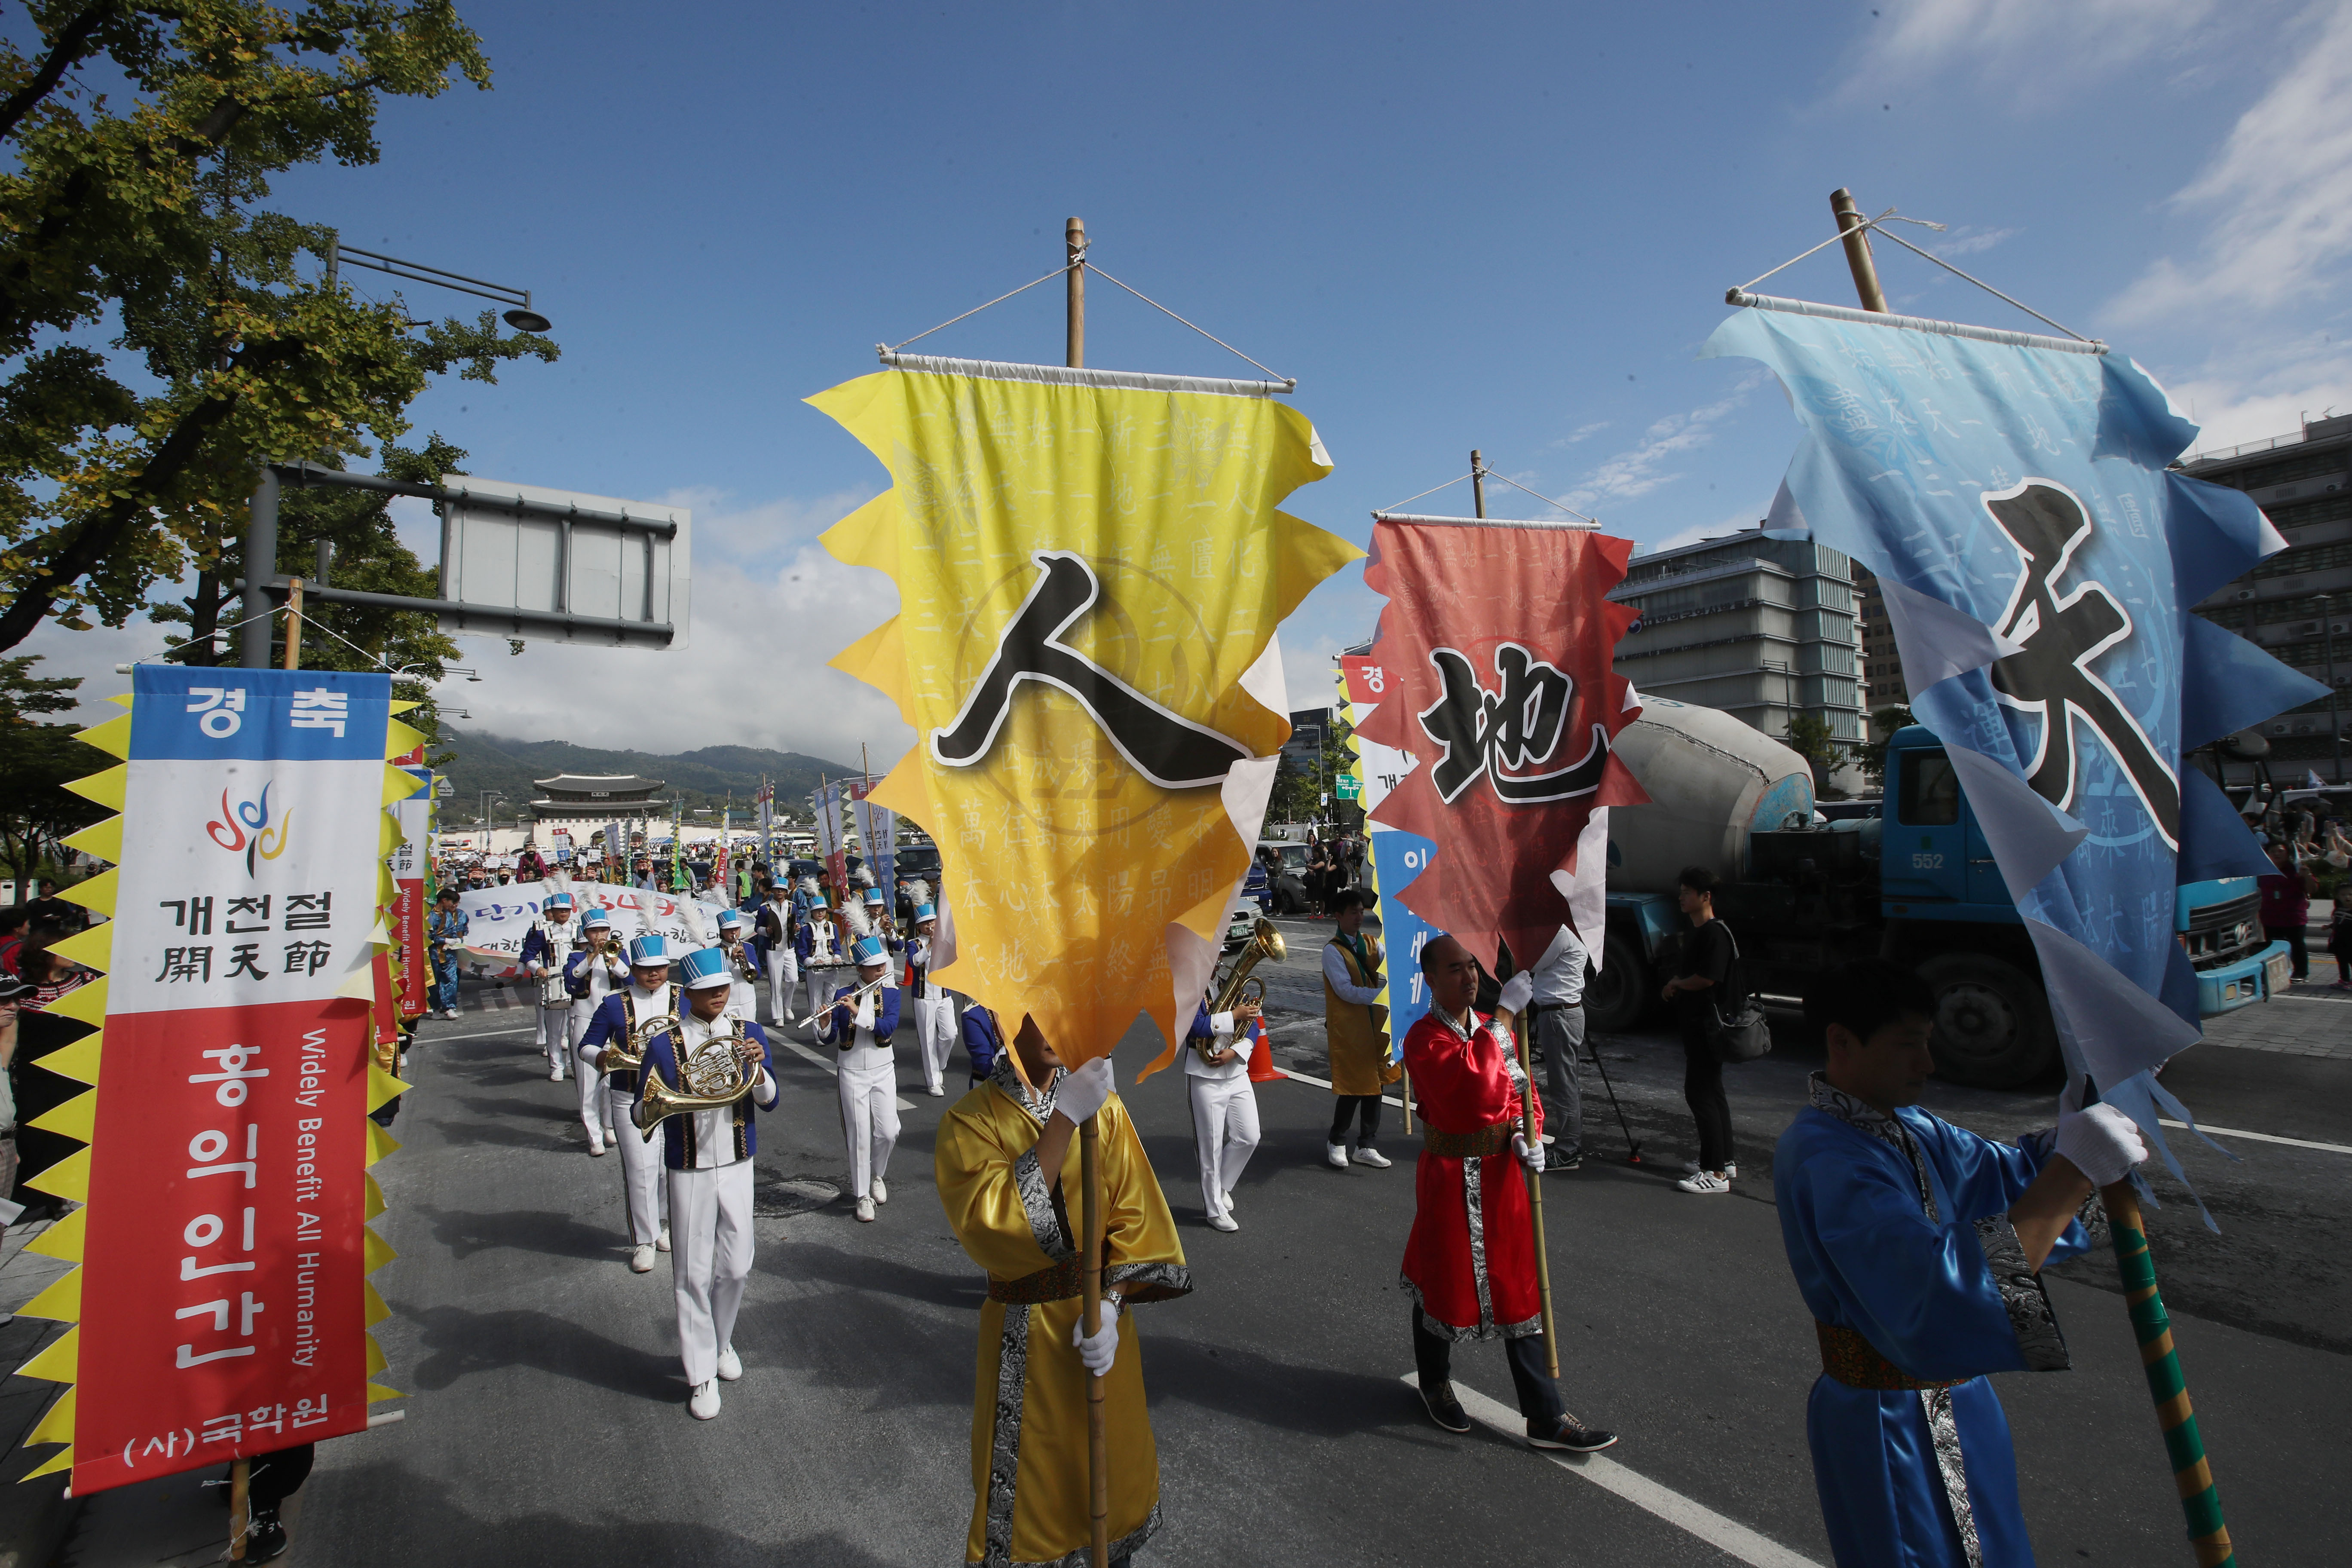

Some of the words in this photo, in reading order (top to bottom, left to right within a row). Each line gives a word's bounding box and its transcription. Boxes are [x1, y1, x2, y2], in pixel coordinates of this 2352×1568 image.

[931, 548, 1250, 790] 人
[1418, 642, 1611, 803] 地
[1912, 853, 1944, 869] 552
[160, 892, 331, 935] 개천절
[401, 887, 411, 913] Widely
[475, 902, 539, 922] 단기
[402, 916, 410, 941] Benefit
[1236, 927, 1248, 936] 8574
[155, 940, 330, 983] 開天節
[295, 1027, 326, 1108] Widely
[296, 1118, 323, 1203] Benefit
[175, 1044, 270, 1369] 홍익인간
[297, 1210, 322, 1242] All
[291, 1253, 320, 1367] Humanity
